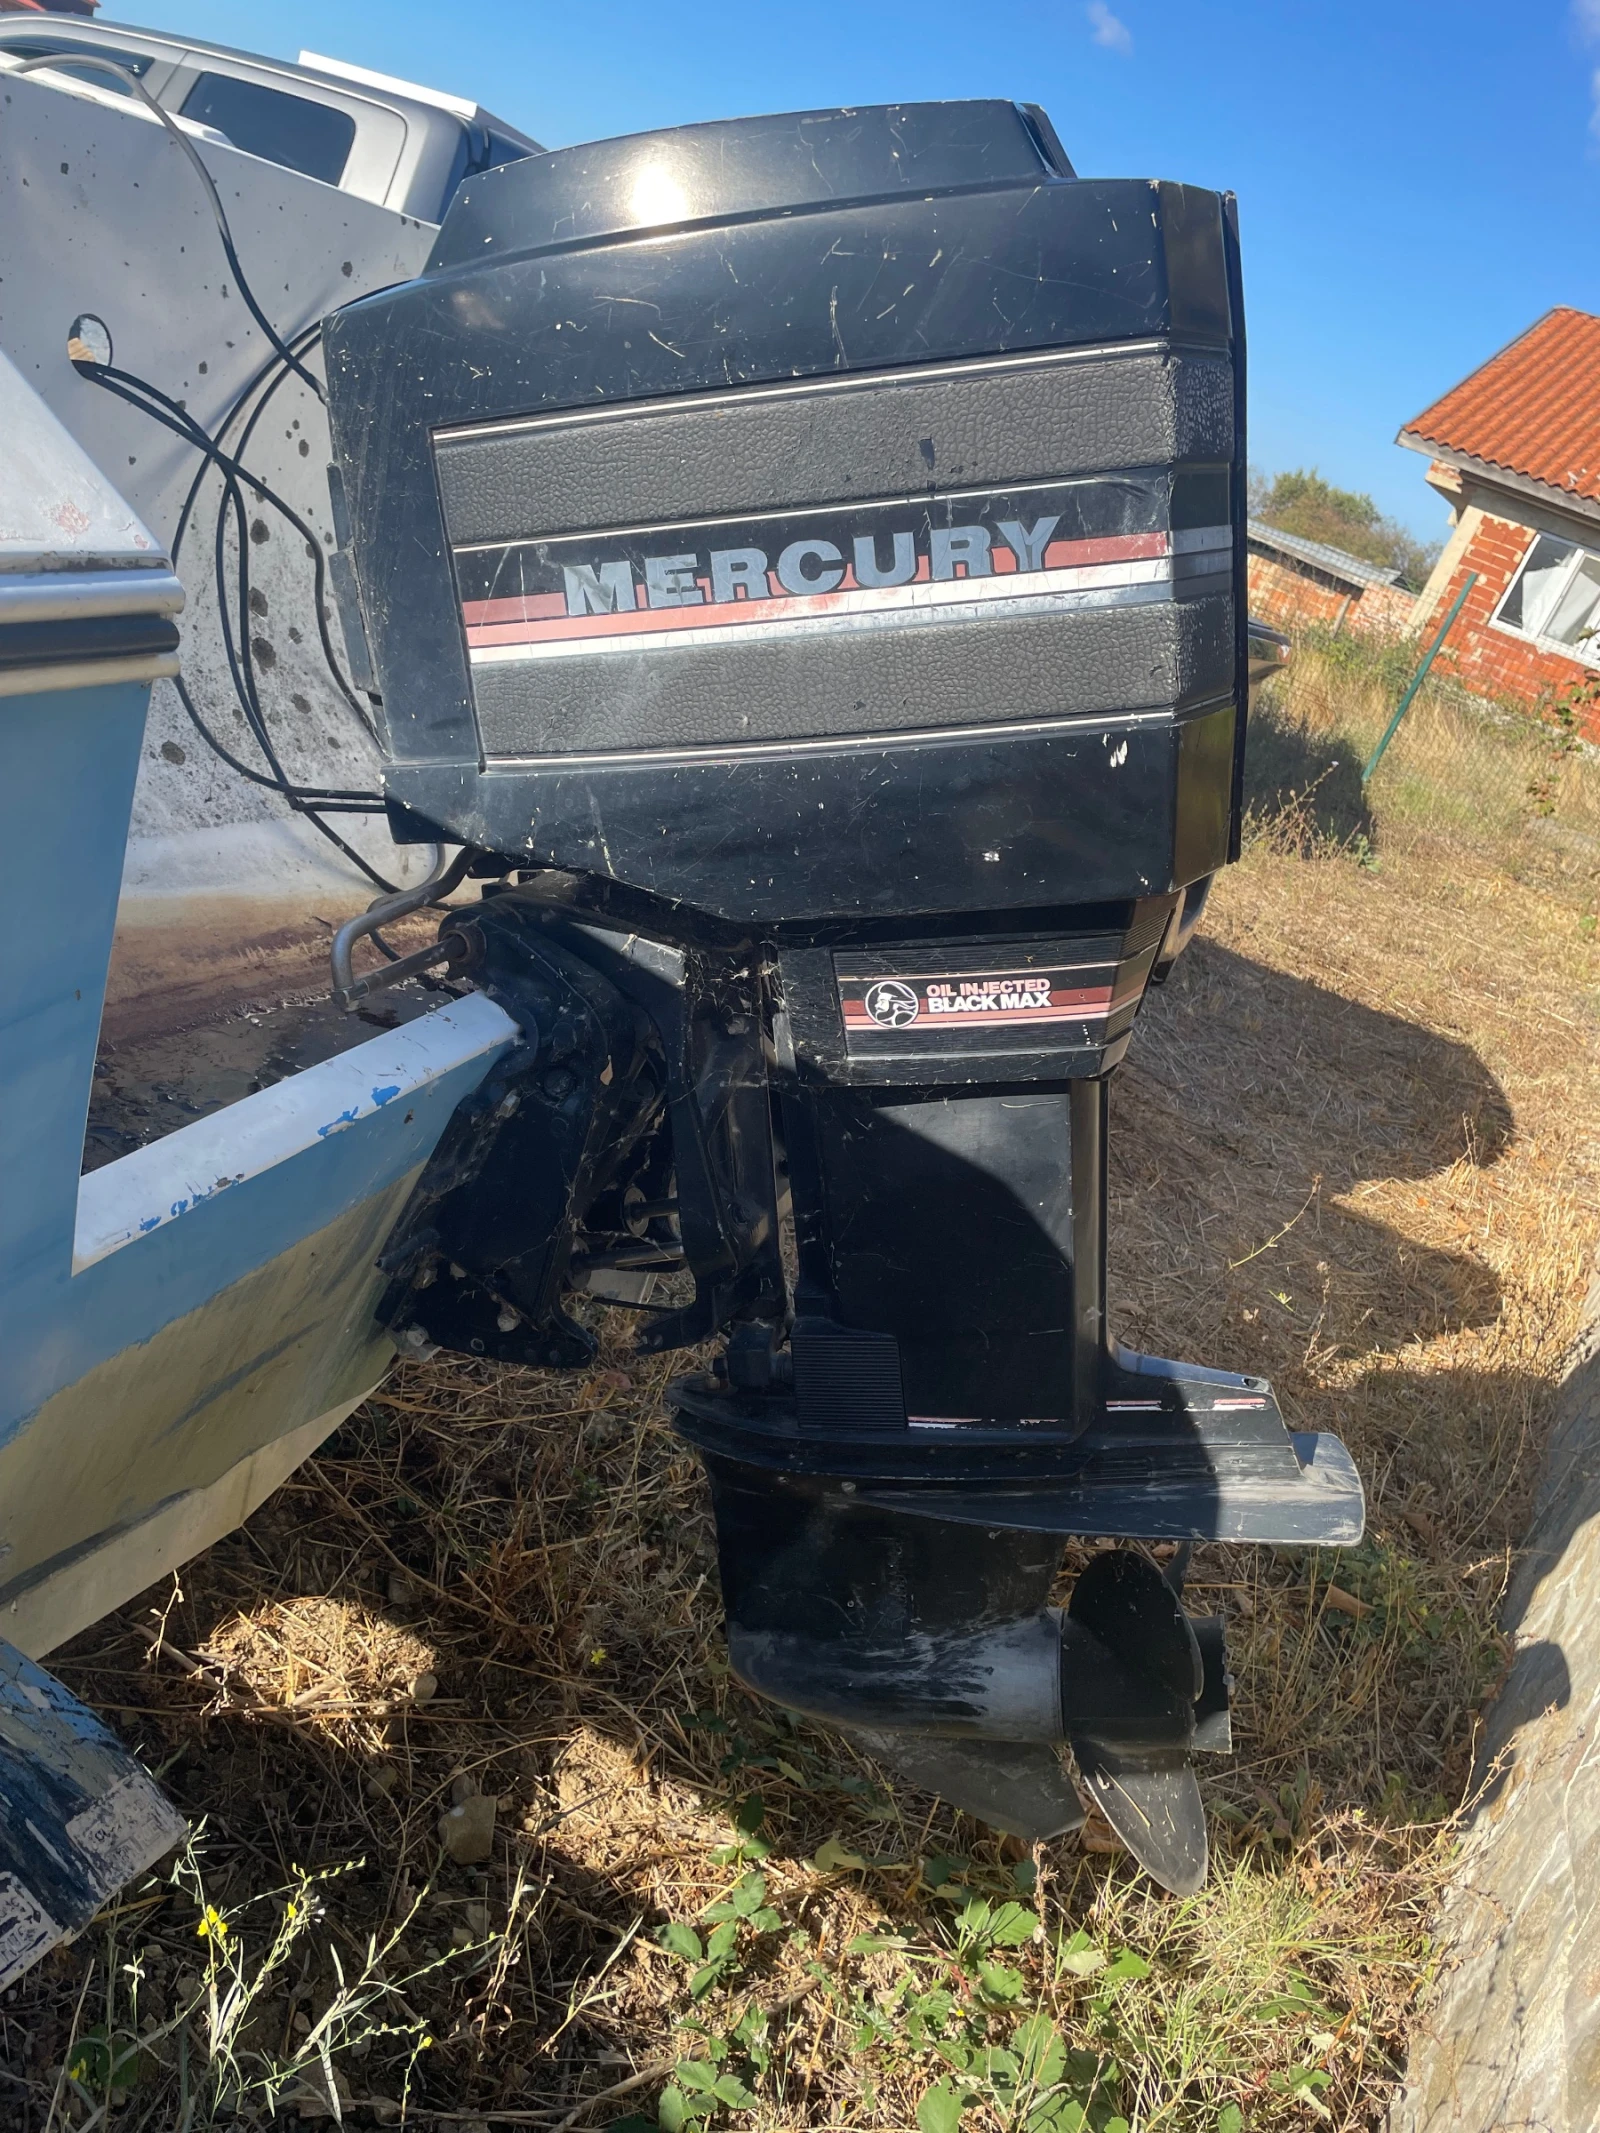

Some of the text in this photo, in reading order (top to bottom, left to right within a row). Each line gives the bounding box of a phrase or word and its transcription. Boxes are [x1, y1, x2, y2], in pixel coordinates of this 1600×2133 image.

[563, 515, 1061, 616] MERCURY
[926, 978, 1051, 997] OIL INJECTED
[928, 991, 1052, 1013] BLACK MAX
